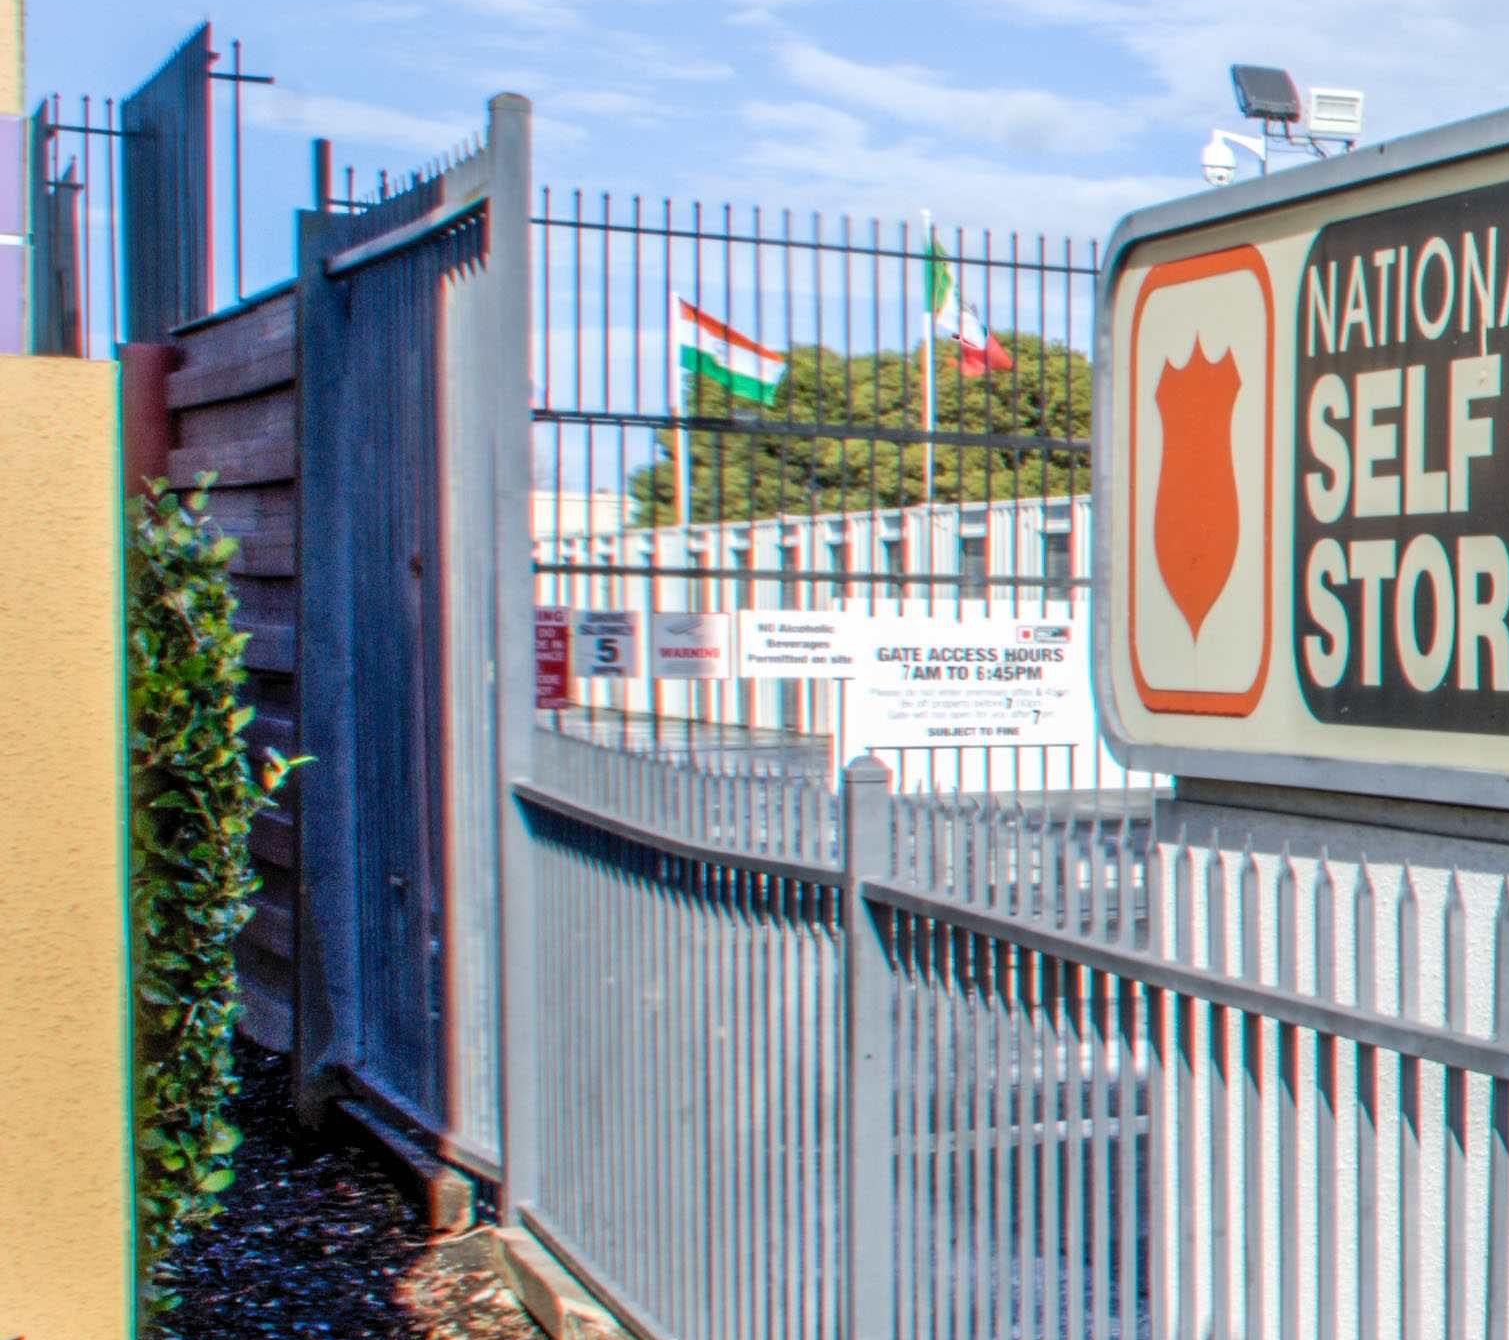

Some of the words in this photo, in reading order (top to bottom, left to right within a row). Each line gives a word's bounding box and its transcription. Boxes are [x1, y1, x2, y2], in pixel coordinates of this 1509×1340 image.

[1305, 354, 1502, 524] SELF
[778, 622, 836, 634] Alcoholic
[596, 638, 620, 663] 5
[766, 638, 831, 651] Beverages
[659, 647, 721, 659] WARNING
[877, 646, 922, 662] GATE
[928, 647, 998, 662] ACCESS
[1004, 647, 1065, 663] HOURS
[947, 666, 969, 681] TO
[928, 726, 976, 737] SUBJECT
[980, 727, 994, 737] TO
[996, 727, 1021, 737] FINE
